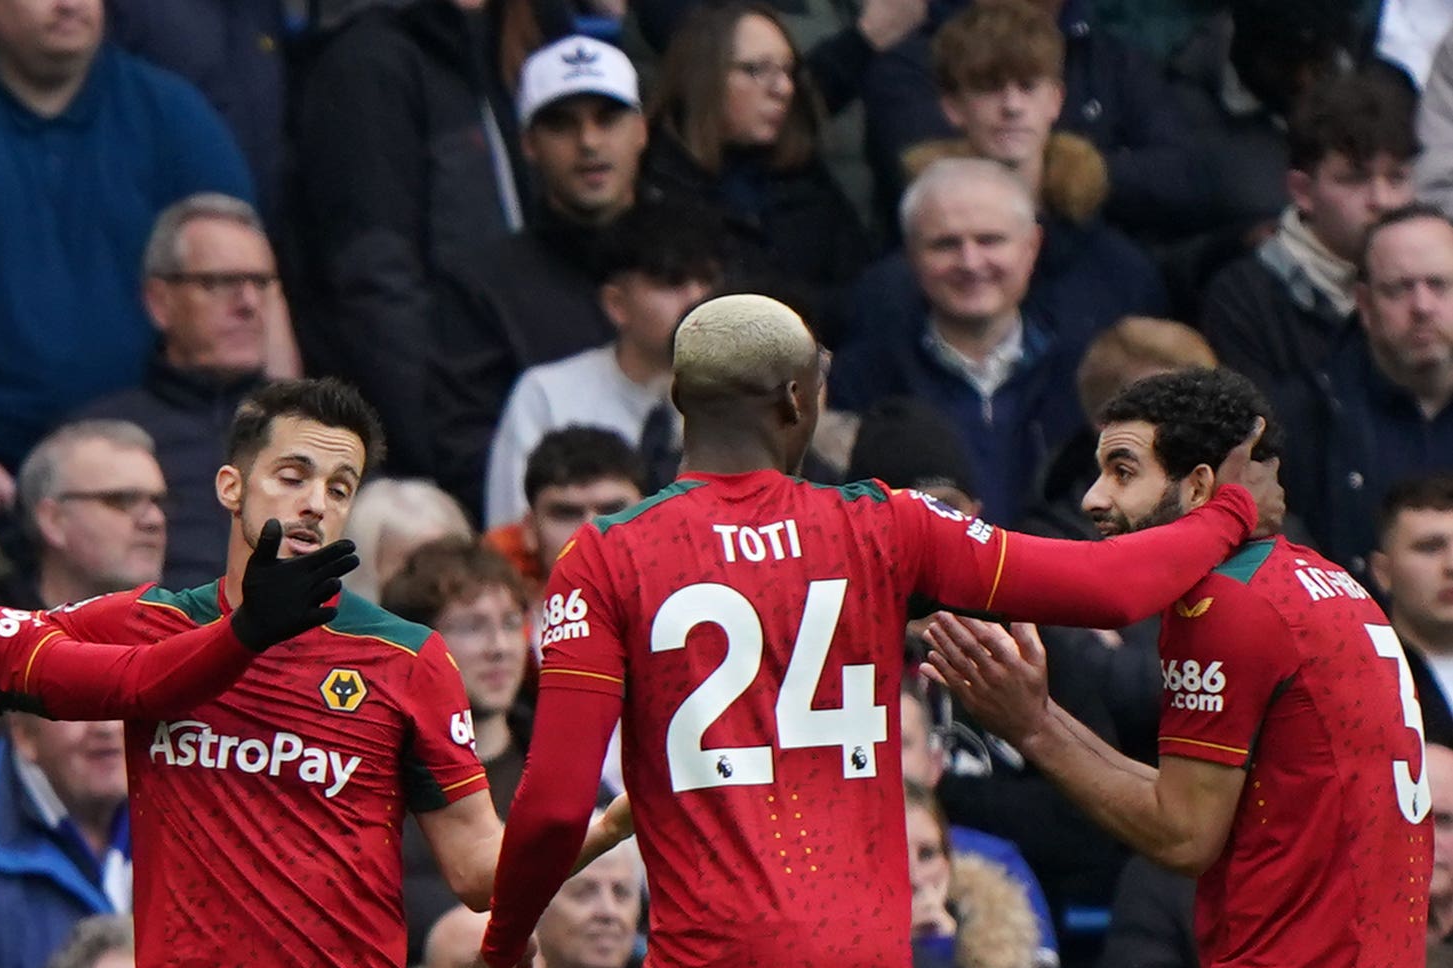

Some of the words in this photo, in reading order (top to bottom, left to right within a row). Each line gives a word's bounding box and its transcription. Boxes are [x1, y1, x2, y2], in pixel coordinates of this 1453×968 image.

[713, 519, 802, 562] TOTI
[651, 578, 888, 793] 24
[1171, 692, 1224, 712] .com
[1364, 624, 1432, 825] 3
[149, 720, 362, 798] AstroPay
